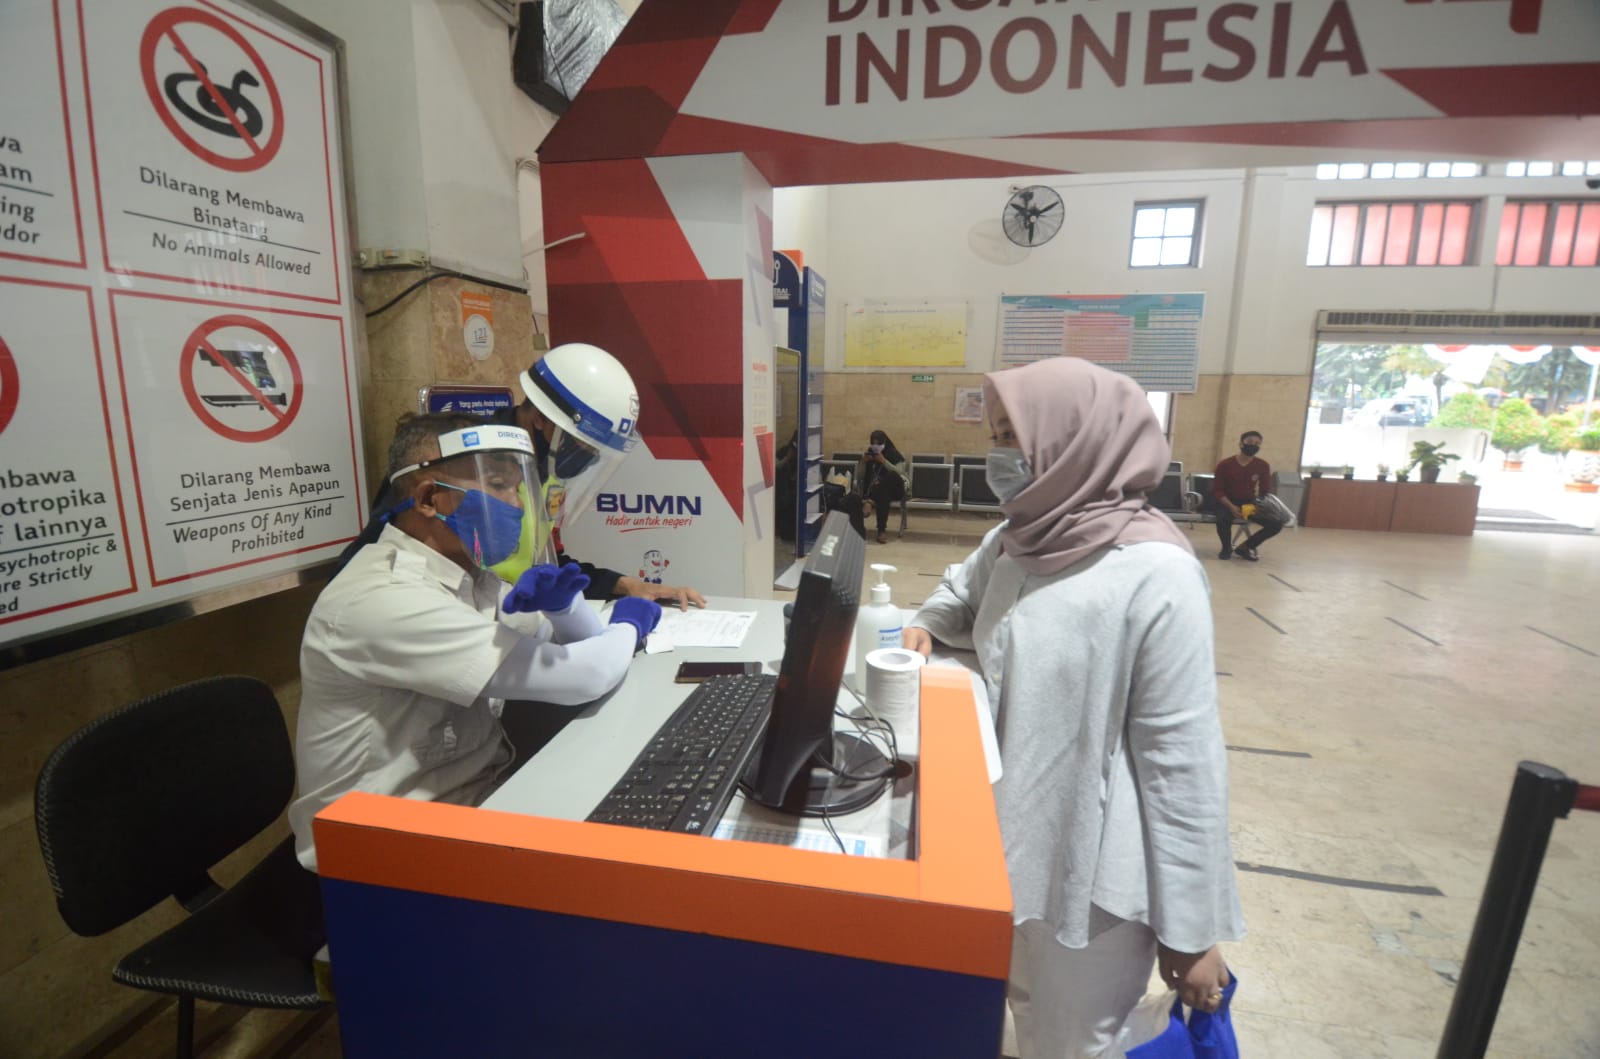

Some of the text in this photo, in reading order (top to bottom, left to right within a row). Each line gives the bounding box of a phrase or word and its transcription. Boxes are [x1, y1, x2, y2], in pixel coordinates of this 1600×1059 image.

[825, 0, 1368, 106] INDONESIA
[139, 166, 305, 223] Dilarang Membawa
[0, 223, 40, 244] dor
[193, 207, 269, 242] Binatang
[152, 232, 311, 276] No Animals Allowed
[181, 463, 331, 489] Dilarang Membawa
[0, 489, 106, 518] otropika
[170, 479, 340, 513] Senjata Jenis Apapun
[596, 493, 702, 516] BUMN
[15, 516, 107, 542] lainnya
[173, 504, 332, 543] Weapons Of Any Kind
[605, 515, 693, 529] Hadir untuk negeri
[106, 539, 117, 552] &
[231, 528, 305, 554] Prohibited
[29, 563, 93, 588] Strictly
